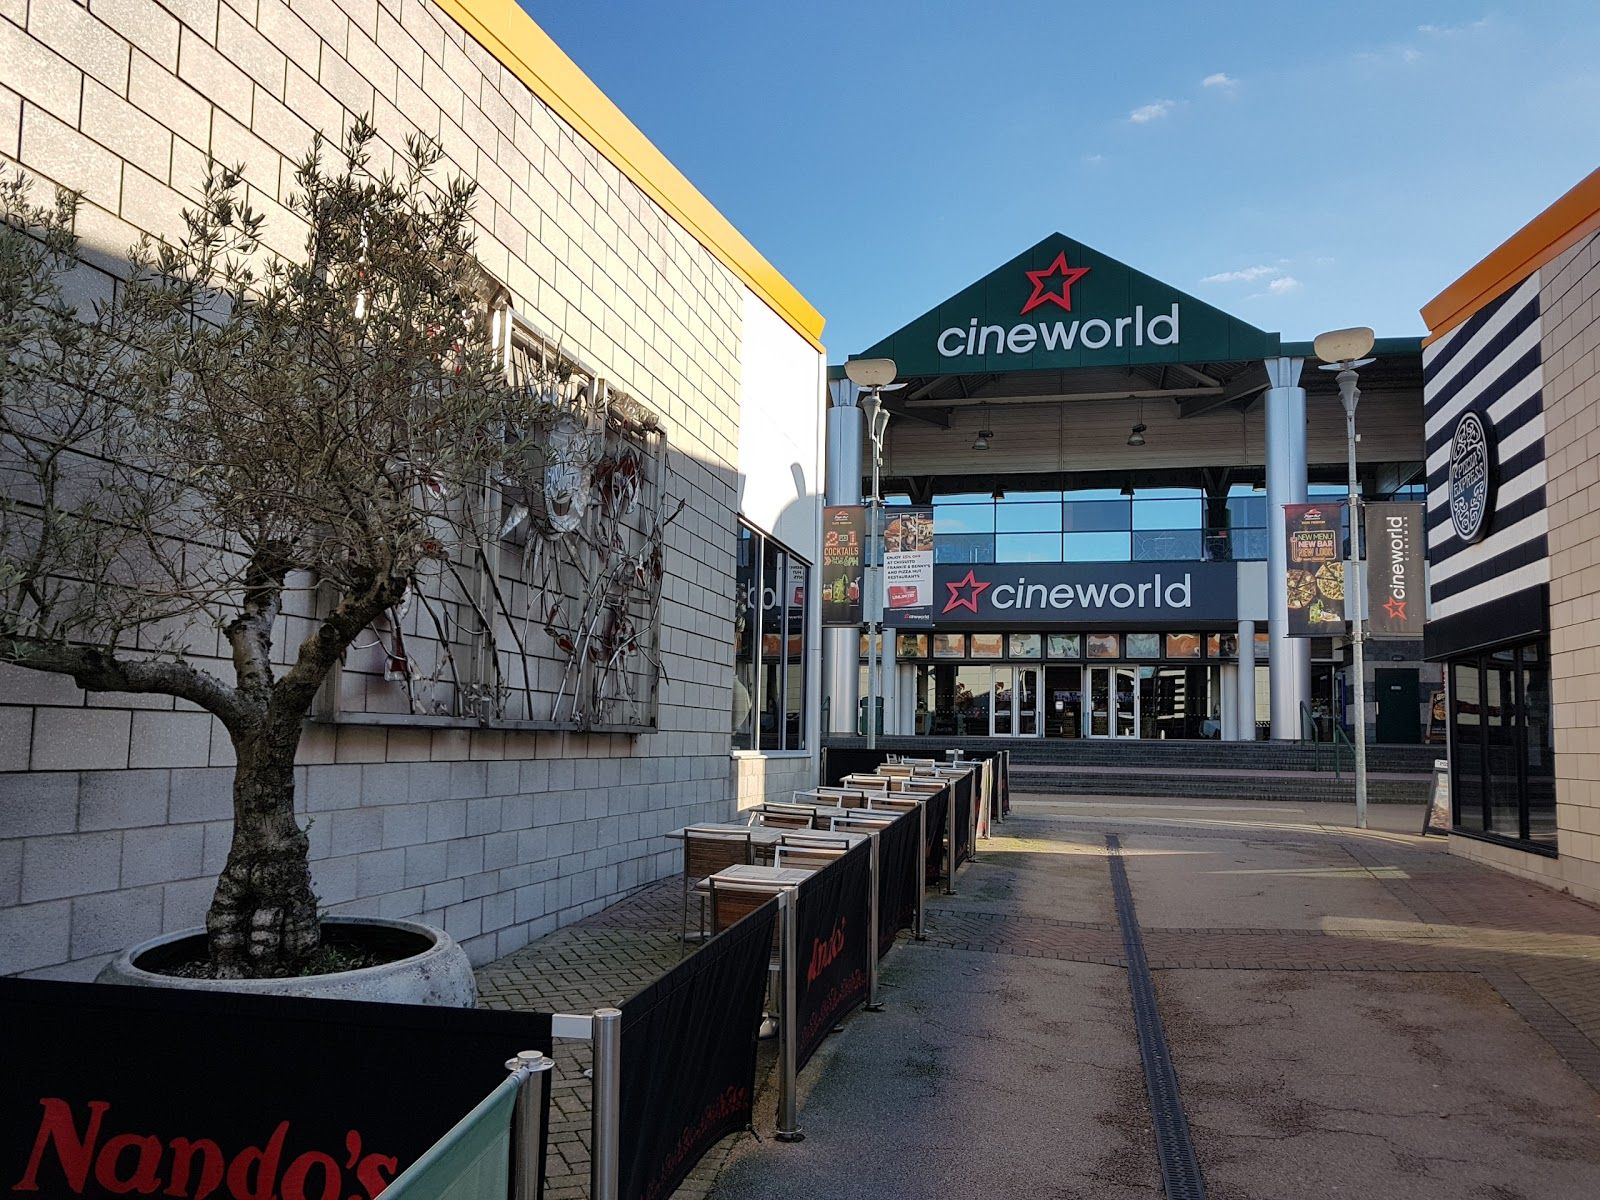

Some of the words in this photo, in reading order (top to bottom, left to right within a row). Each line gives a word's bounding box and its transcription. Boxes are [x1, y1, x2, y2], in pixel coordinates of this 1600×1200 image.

[937, 303, 1179, 357] cineworld
[1453, 462, 1483, 497] EXPRESS
[824, 547, 859, 555] COCKTAILS
[826, 531, 838, 546] 2
[849, 530, 857, 545] 1
[1298, 540, 1316, 548] NEW
[1298, 548, 1314, 557] NEW
[1386, 516, 1406, 599] cineworld
[991, 573, 1192, 609] cineworld
[12, 1098, 398, 1200] Nando's
